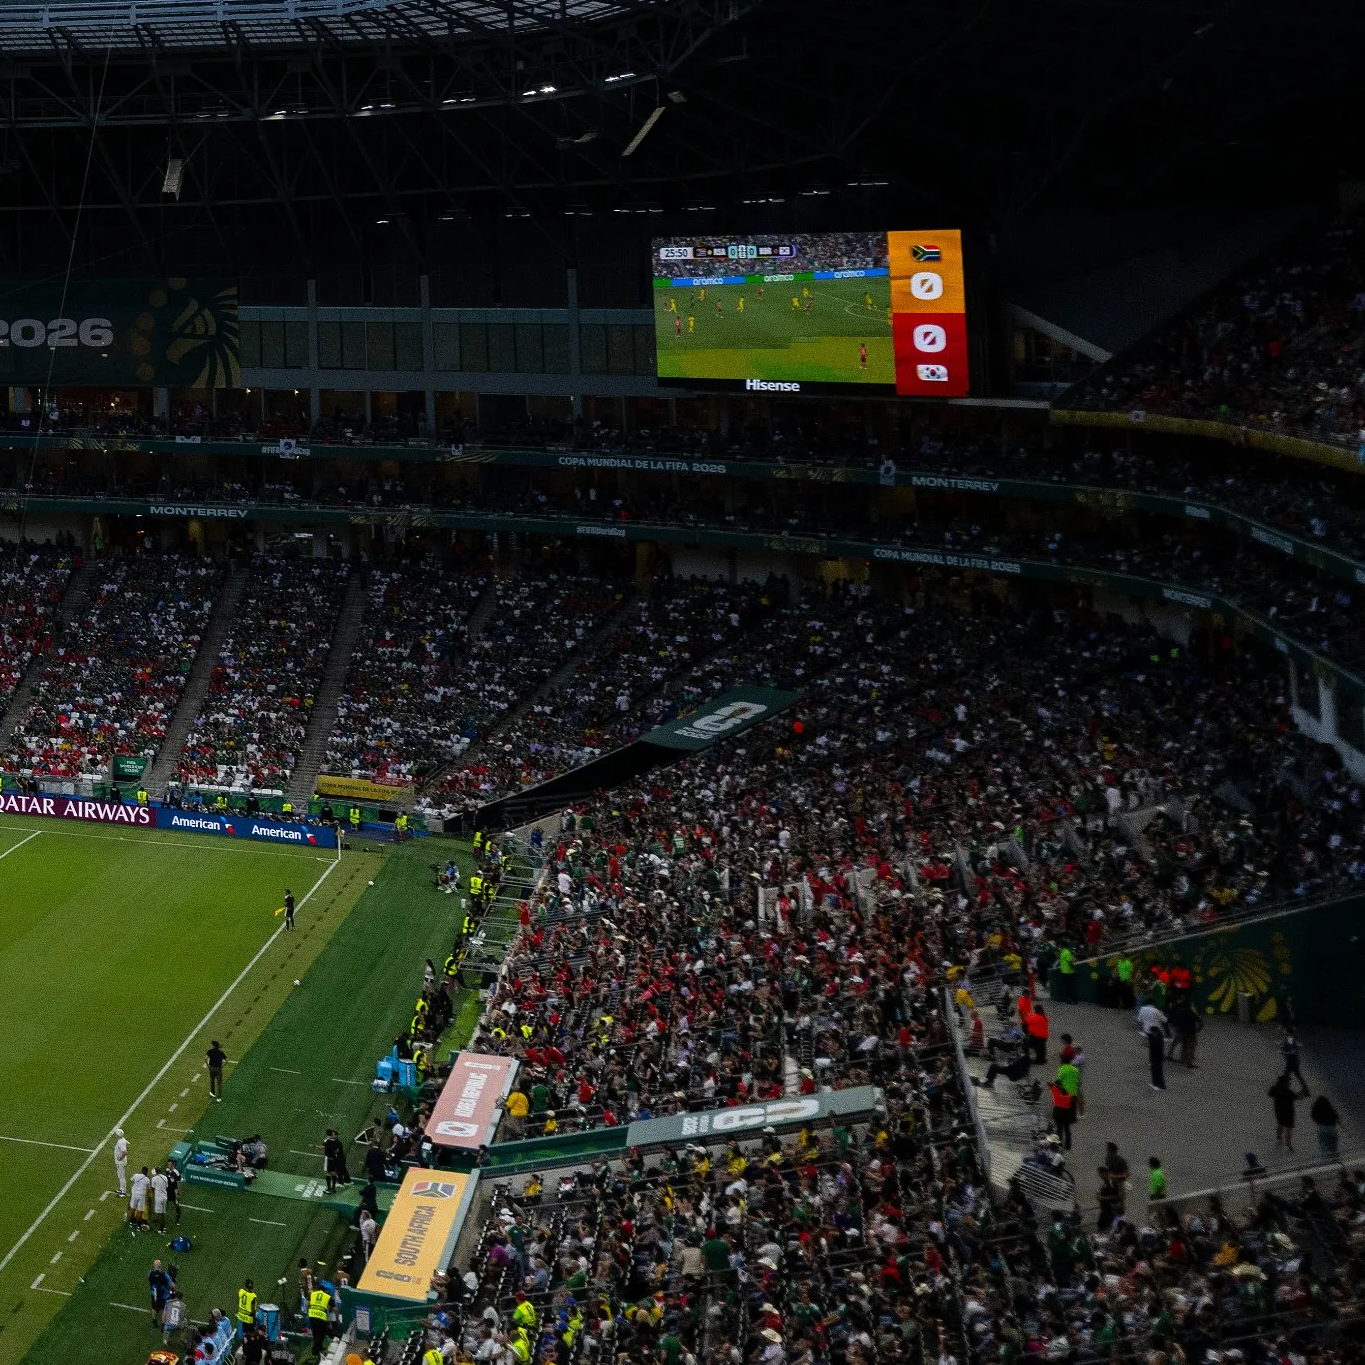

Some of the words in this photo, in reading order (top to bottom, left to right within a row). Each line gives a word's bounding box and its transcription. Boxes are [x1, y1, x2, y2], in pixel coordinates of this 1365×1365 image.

[665, 248, 688, 258] 25:50
[745, 378, 801, 392] Hisense
[558, 457, 586, 467] COPA
[586, 457, 634, 469] MUNDIAL
[635, 459, 649, 470] DE
[649, 460, 664, 470] LA
[665, 460, 689, 471] FIFA
[692, 463, 727, 474] 2026
[911, 475, 999, 492] MONTERREY
[149, 505, 249, 518] MONTERREY
[63, 803, 150, 824] AIRWAYS
[171, 816, 221, 831] American
[251, 824, 302, 840] American
[407, 1205, 438, 1235] AFRICA
[394, 1235, 426, 1266] SOUTH
